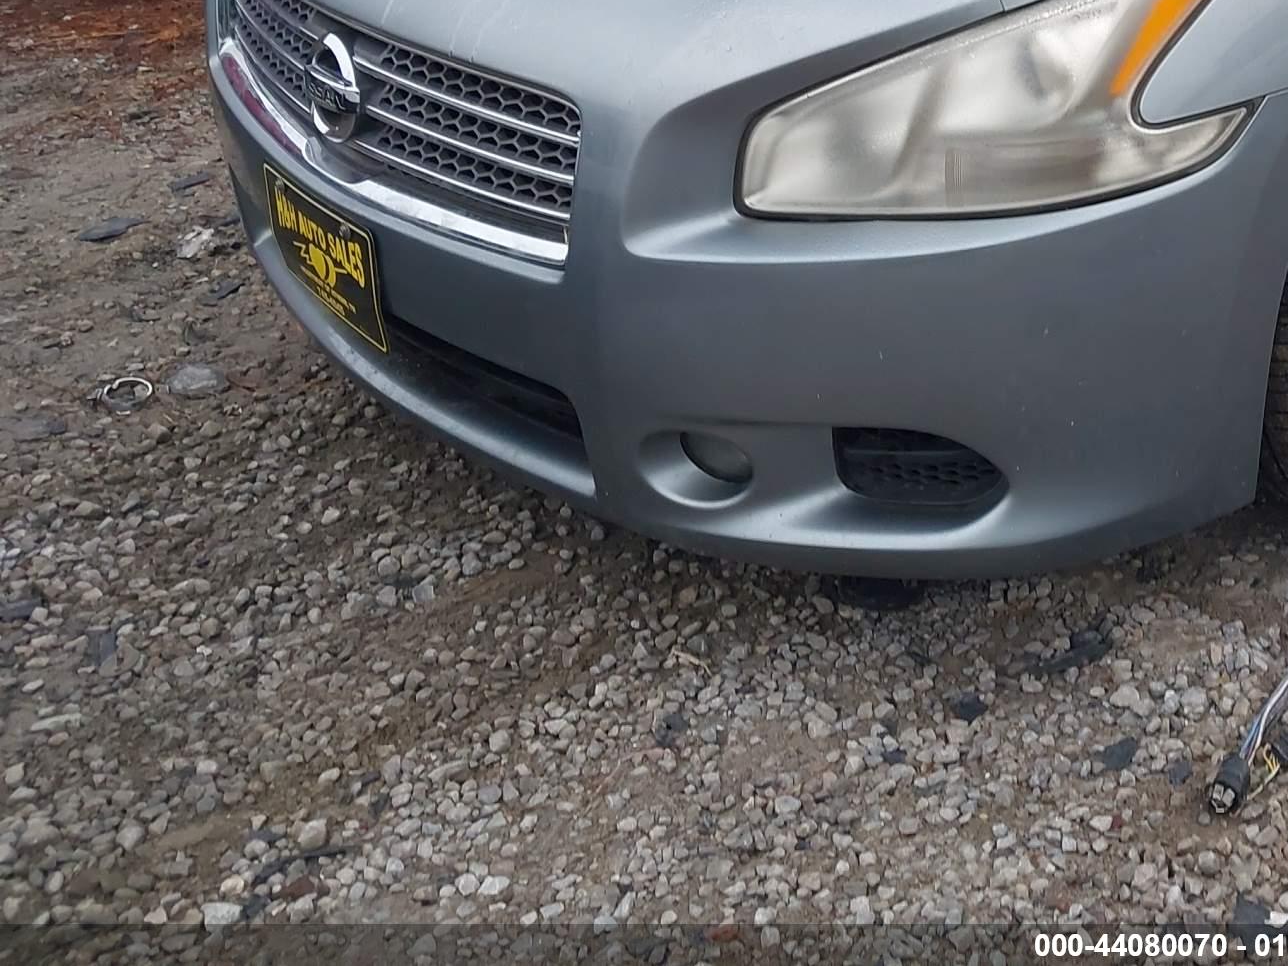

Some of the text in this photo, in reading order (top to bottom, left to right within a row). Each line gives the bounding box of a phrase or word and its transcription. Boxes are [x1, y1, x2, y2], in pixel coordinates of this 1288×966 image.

[274, 185, 365, 288] H&H AUTO SALES
